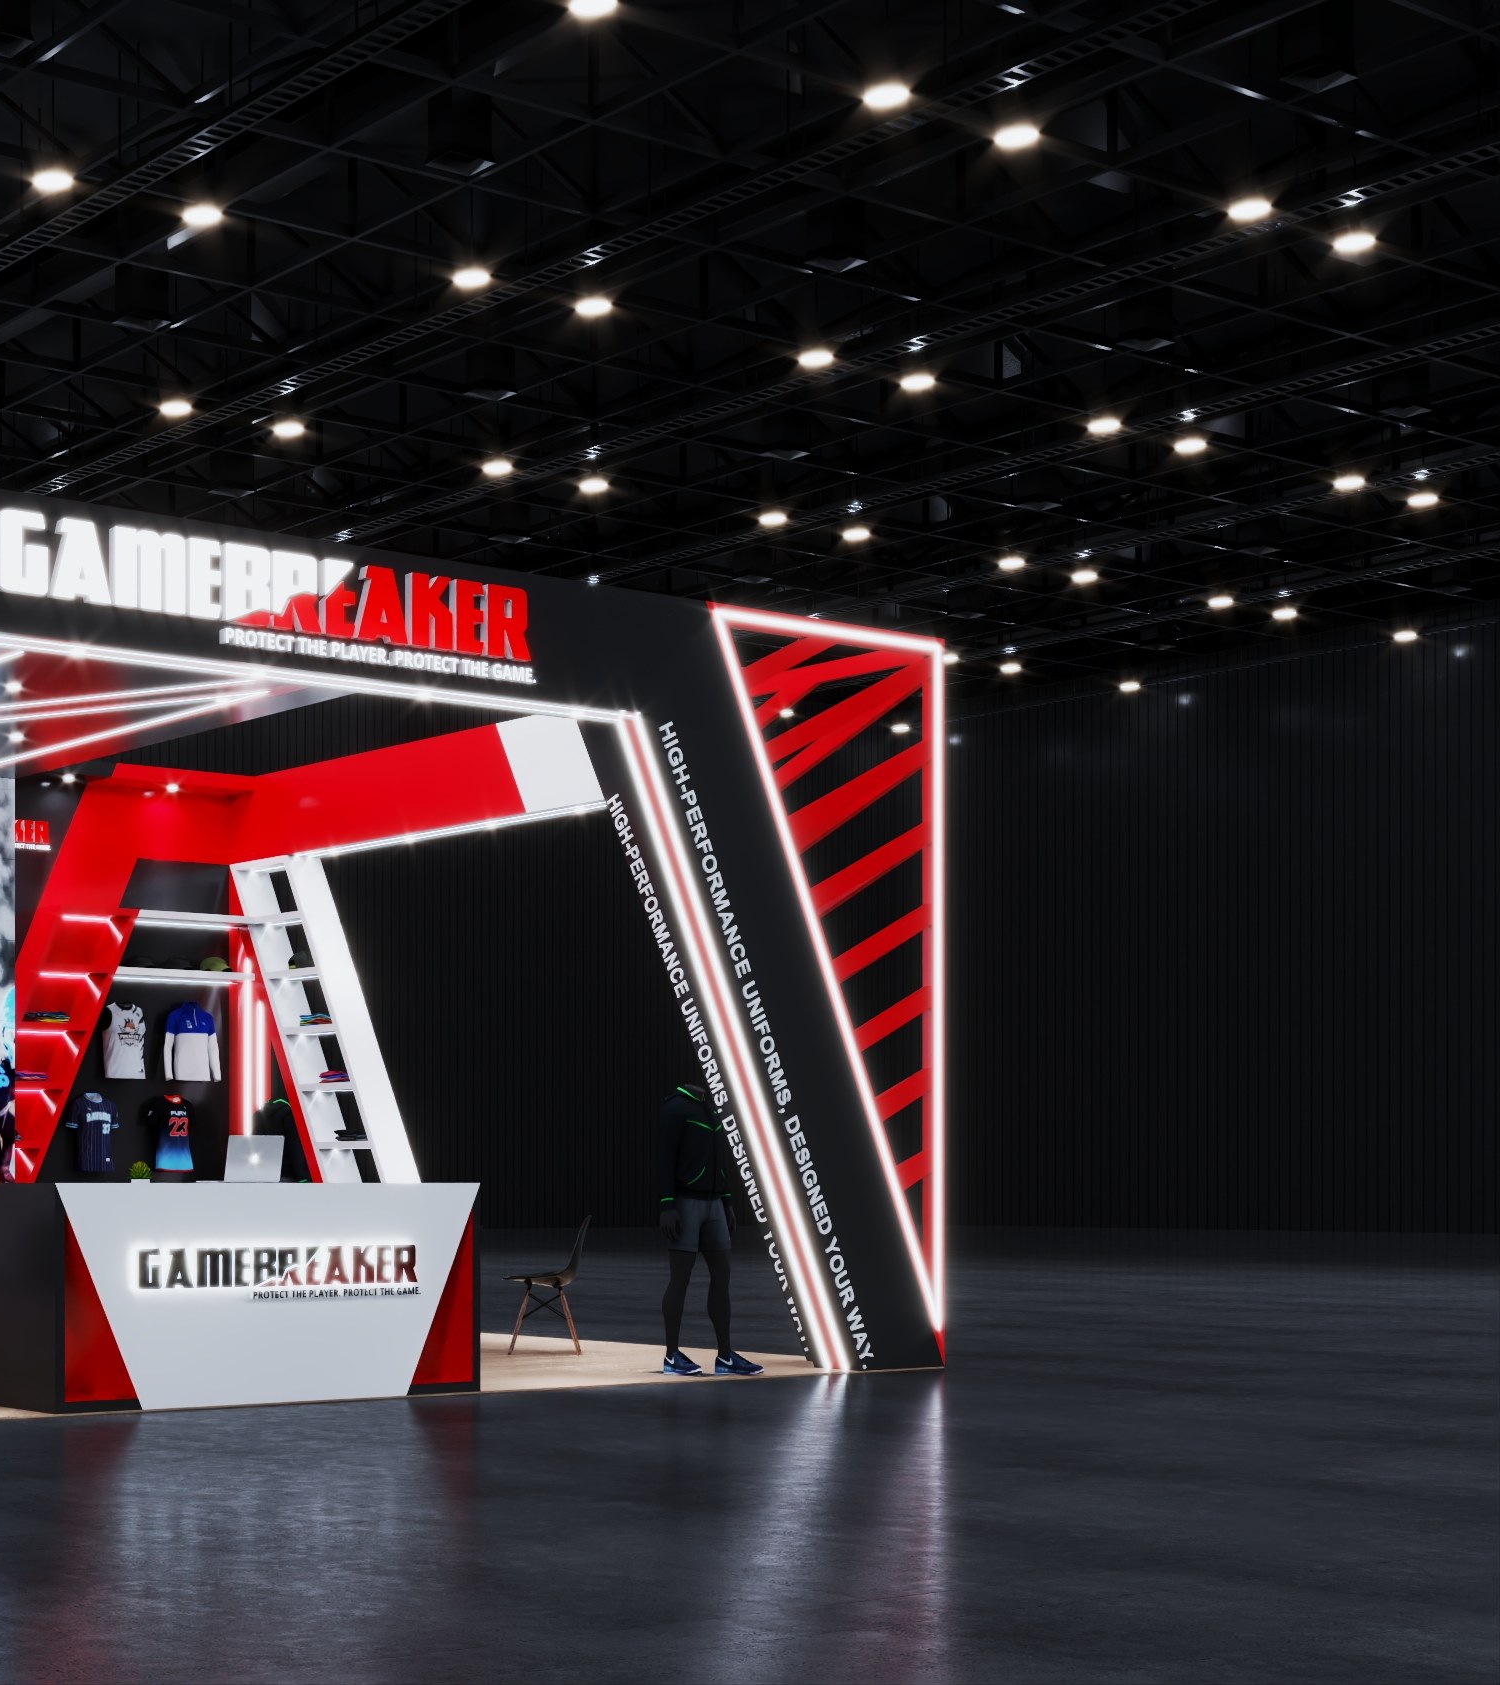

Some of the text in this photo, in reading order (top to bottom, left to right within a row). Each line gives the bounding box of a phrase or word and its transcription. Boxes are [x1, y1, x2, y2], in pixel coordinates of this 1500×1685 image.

[220, 627, 537, 684] PROTECT THE PLAYER. PROTECT THE GAME.
[606, 793, 690, 998] HIGH-PERFORMANCE
[658, 720, 752, 979] HIGH-PERFORMANCE
[784, 1114, 833, 1235] DESIGNED
[825, 1236, 855, 1308] YOUR
[846, 1306, 874, 1370] WAY.
[168, 1117, 189, 1137] 23
[138, 1243, 419, 1290] GAMEBREAKER
[252, 1290, 289, 1300] PROTECT
[292, 1289, 307, 1299] THE
[343, 1288, 378, 1297] PROTECT
[381, 1287, 395, 1296] THE
